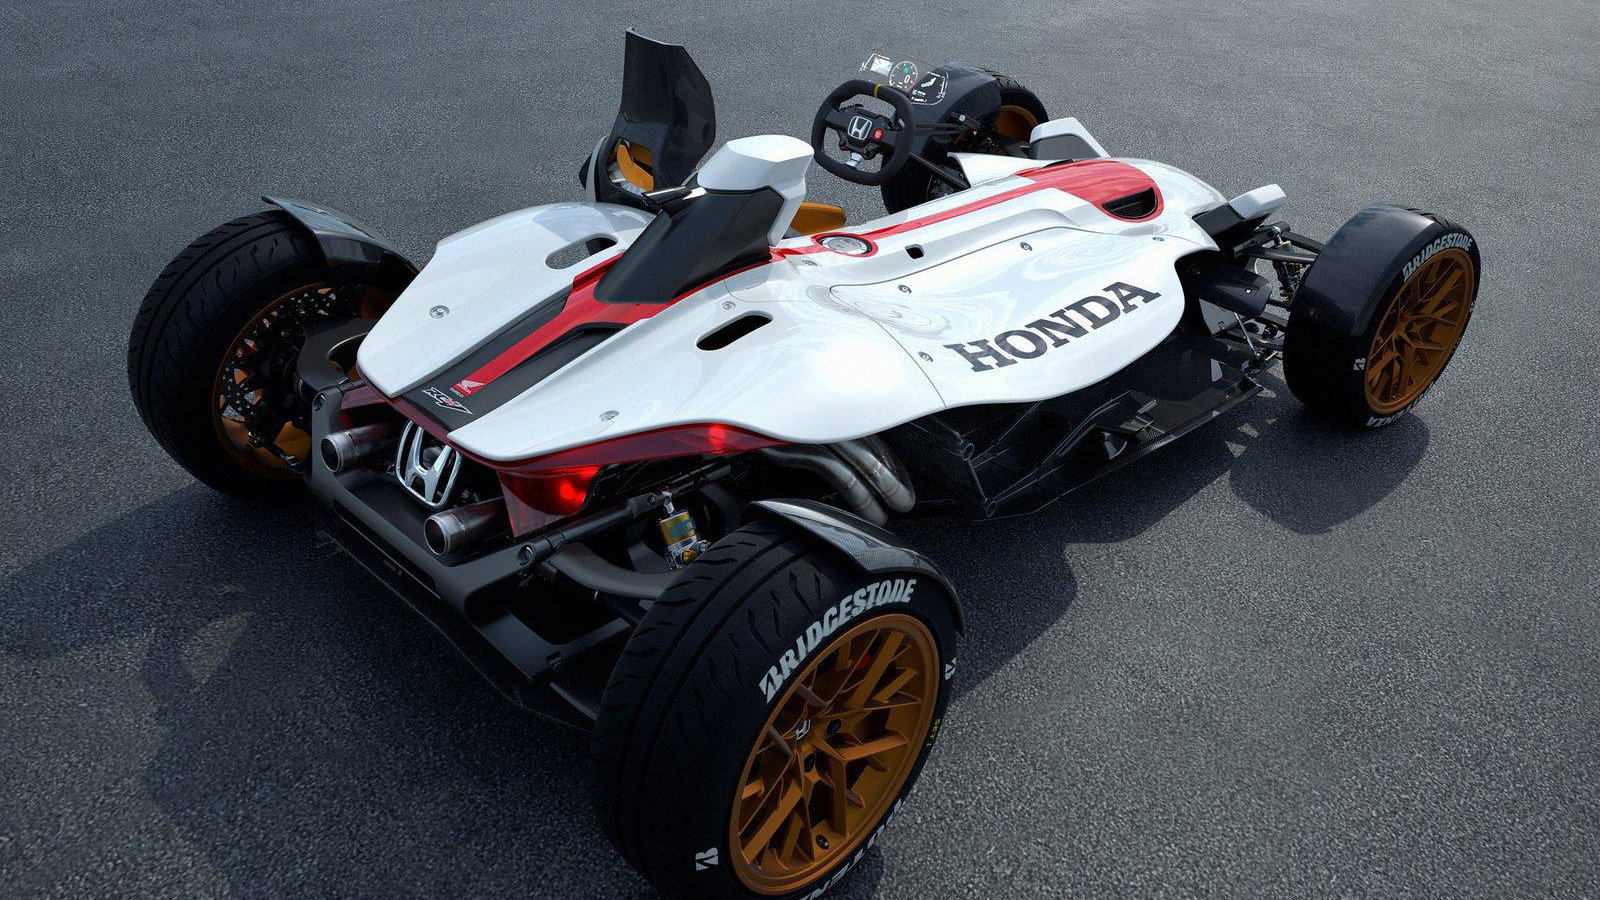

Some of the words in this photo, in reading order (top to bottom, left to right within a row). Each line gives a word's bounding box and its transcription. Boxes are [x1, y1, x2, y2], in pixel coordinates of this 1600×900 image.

[1403, 232, 1473, 282] BRIDGESTONE
[943, 280, 1162, 372] HONDA
[758, 578, 918, 704] BRIDGESTONE
